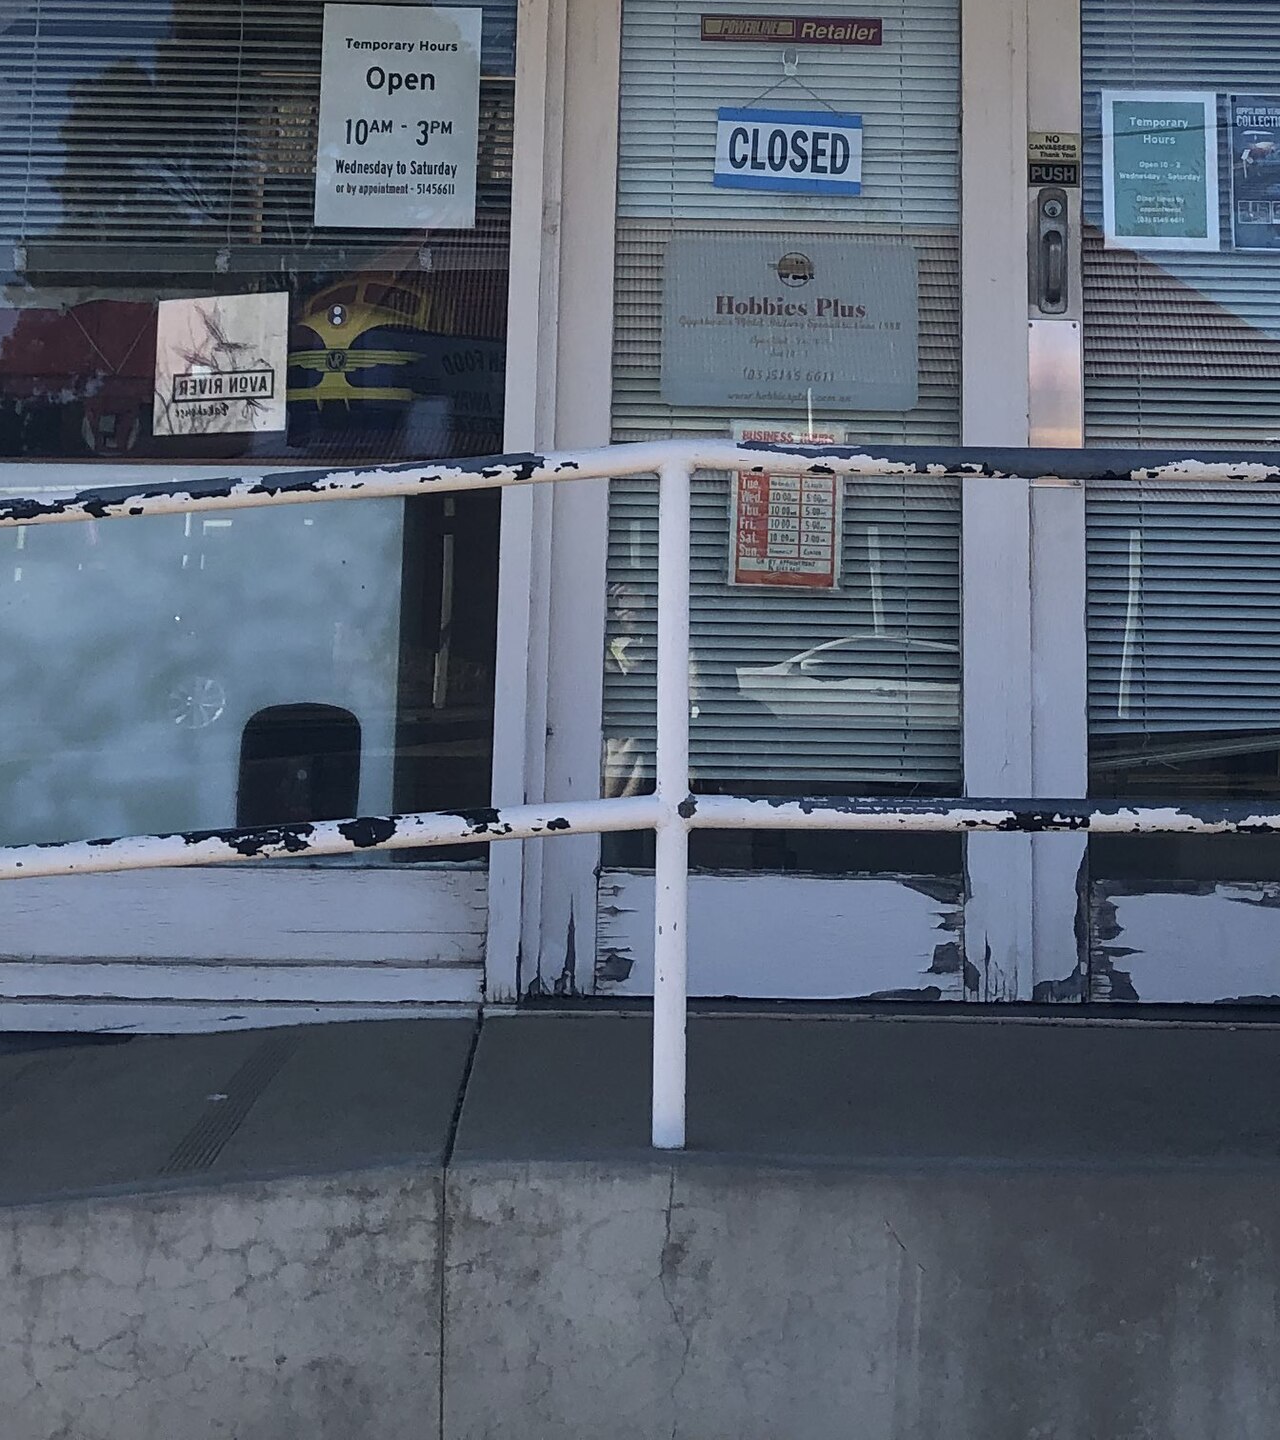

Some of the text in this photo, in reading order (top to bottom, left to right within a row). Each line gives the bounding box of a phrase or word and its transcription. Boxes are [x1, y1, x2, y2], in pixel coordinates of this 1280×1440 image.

[801, 22, 879, 41] Retailer
[345, 38, 458, 53] Temporary Hours
[366, 66, 435, 95] Open
[1129, 116, 1188, 129] Temporary
[345, 118, 393, 145] 10AM
[415, 120, 453, 146] 3PM
[1045, 134, 1060, 143] NO
[1143, 134, 1176, 145] Hours
[728, 126, 850, 175] CLOSED
[335, 159, 457, 178] Wednesday to Saturday
[1139, 161, 1159, 169] Open
[1031, 166, 1074, 181] PUSH
[1119, 172, 1161, 180] Wednesday
[1167, 172, 1201, 182] Saturday
[335, 185, 344, 194] or
[346, 183, 356, 195] by
[359, 183, 409, 195] appointment
[416, 183, 455, 195] 51456611
[716, 295, 867, 318] Hobbies Plus
[742, 429, 794, 444] BUSINESS
[739, 531, 759, 544] Sat.
